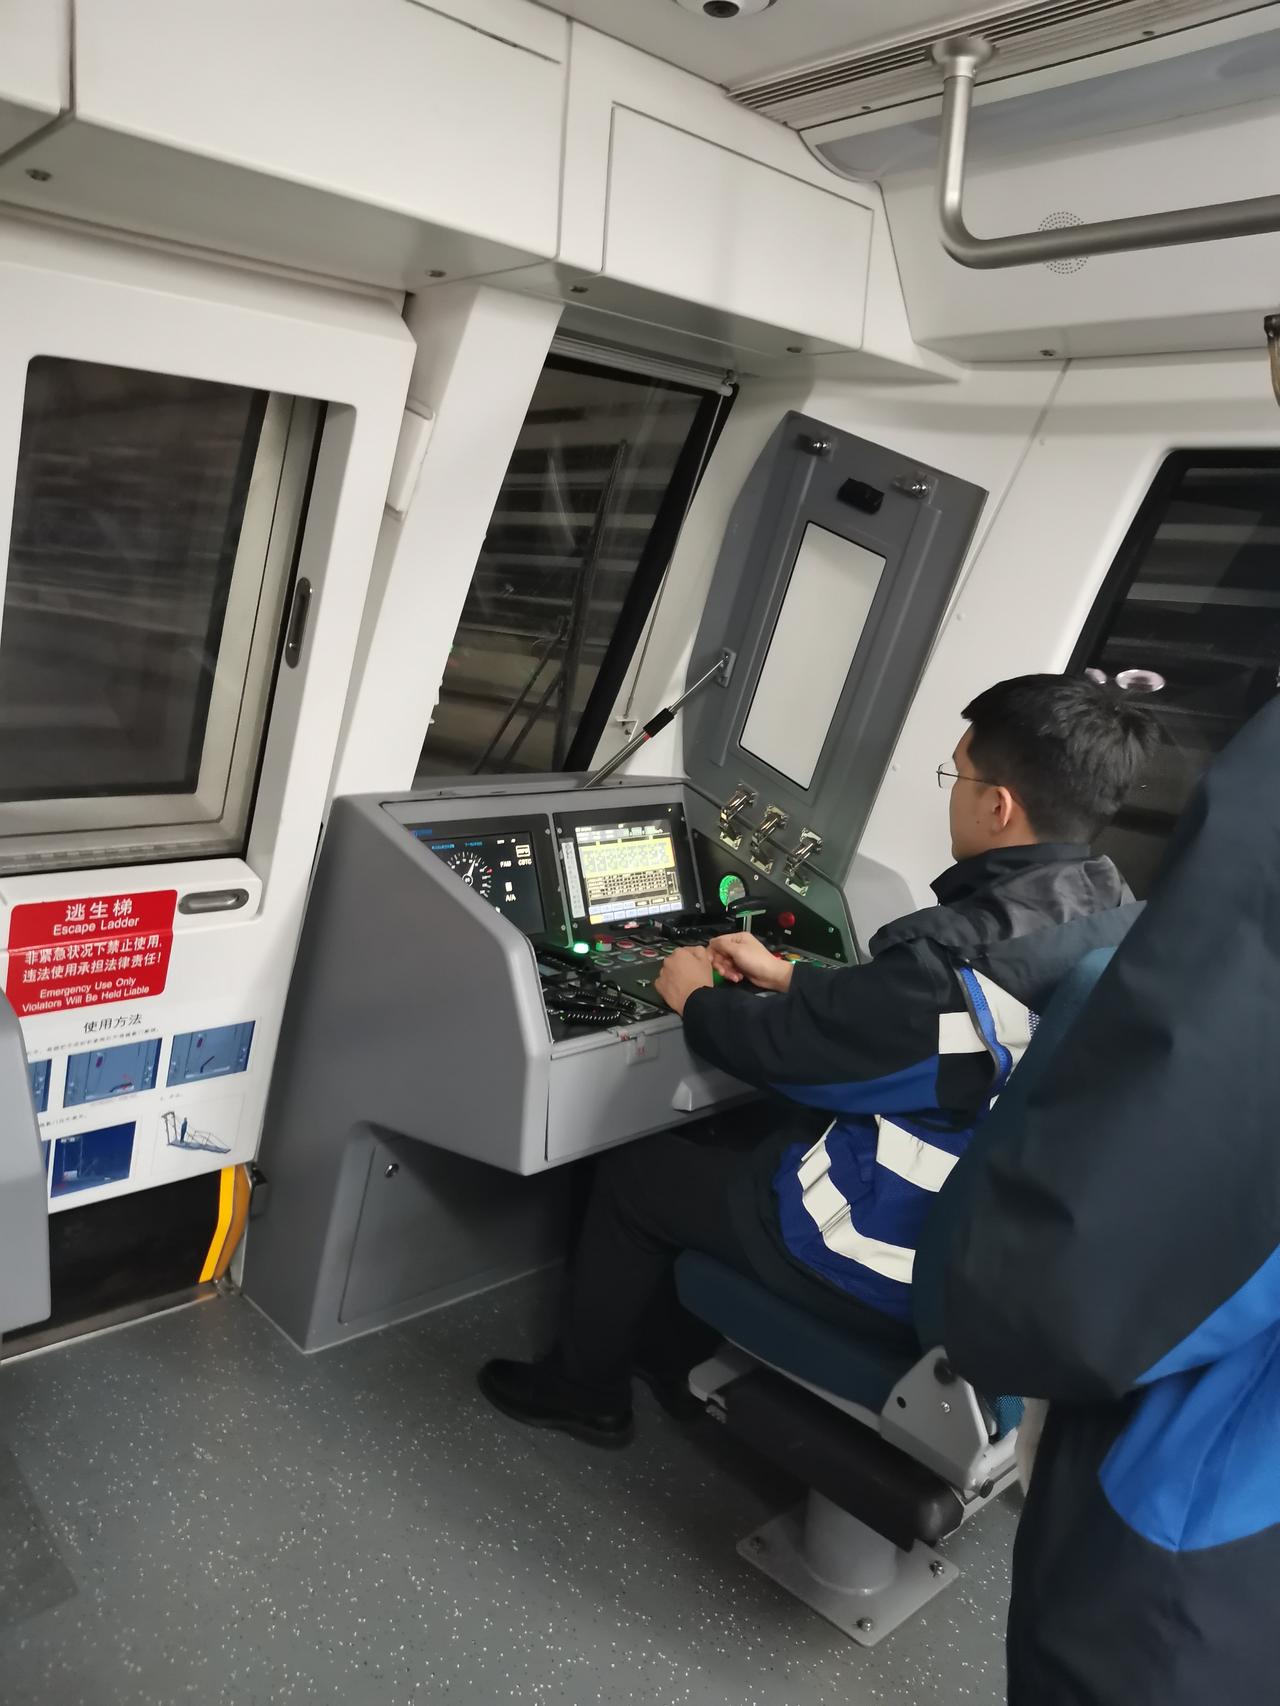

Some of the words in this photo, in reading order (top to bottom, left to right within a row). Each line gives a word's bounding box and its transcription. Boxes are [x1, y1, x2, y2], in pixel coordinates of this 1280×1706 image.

[65, 898, 133, 922] 逃生梯
[53, 922, 96, 936] Escape
[100, 916, 140, 931] Ladder
[22, 1000, 62, 1013] Violators
[65, 994, 82, 1006] Will
[85, 993, 98, 1002] Be
[101, 988, 122, 1001] Held
[123, 985, 150, 997] Liable
[39, 983, 92, 999] Emergency
[94, 981, 113, 991] Use
[115, 976, 137, 987] Only
[83, 1013, 143, 1034] 使用方法
